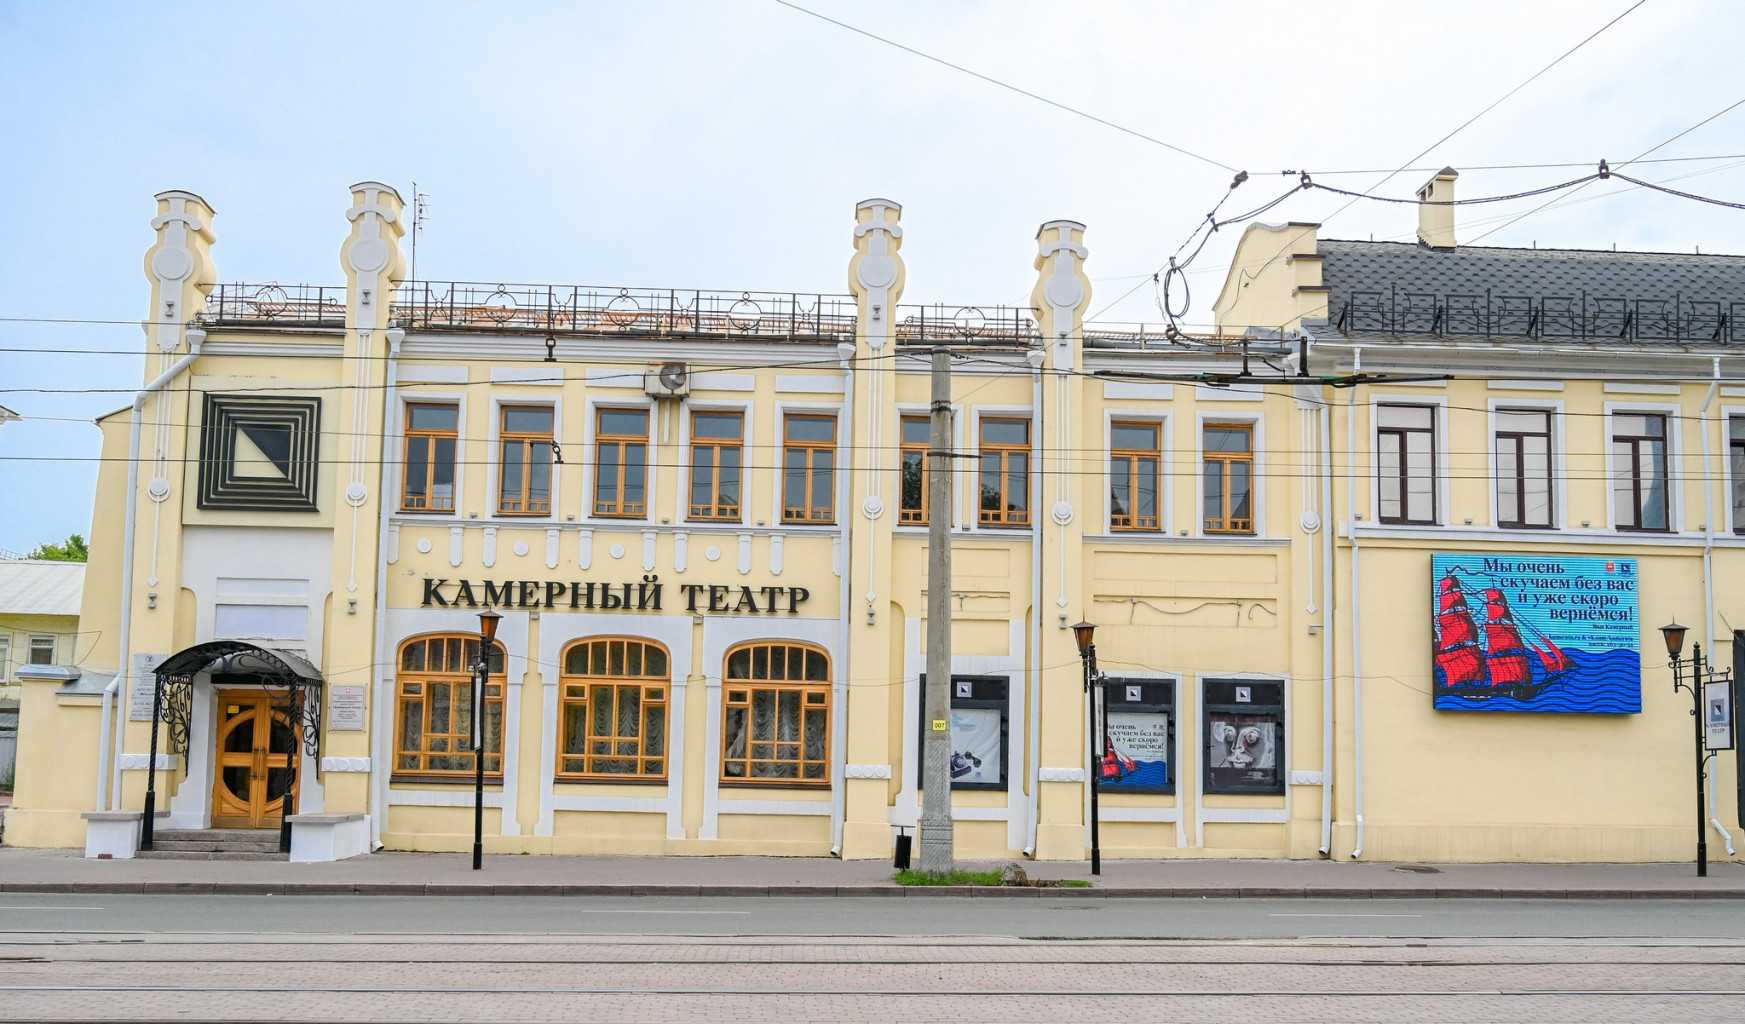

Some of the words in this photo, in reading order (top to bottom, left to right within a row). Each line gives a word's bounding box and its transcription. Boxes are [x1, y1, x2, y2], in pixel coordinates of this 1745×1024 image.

[1483, 558, 1512, 572] Мы
[1517, 562, 1565, 573] очень
[1501, 578, 1570, 591] скучаем
[1575, 576, 1602, 590] без
[1607, 580, 1634, 590] вас
[421, 575, 664, 610] КАМЕРНЫЙ
[680, 584, 810, 613] ТЕАТР
[1534, 594, 1567, 607] уже
[1571, 594, 1619, 608] скоро
[1550, 606, 1633, 623] вернёмся!
